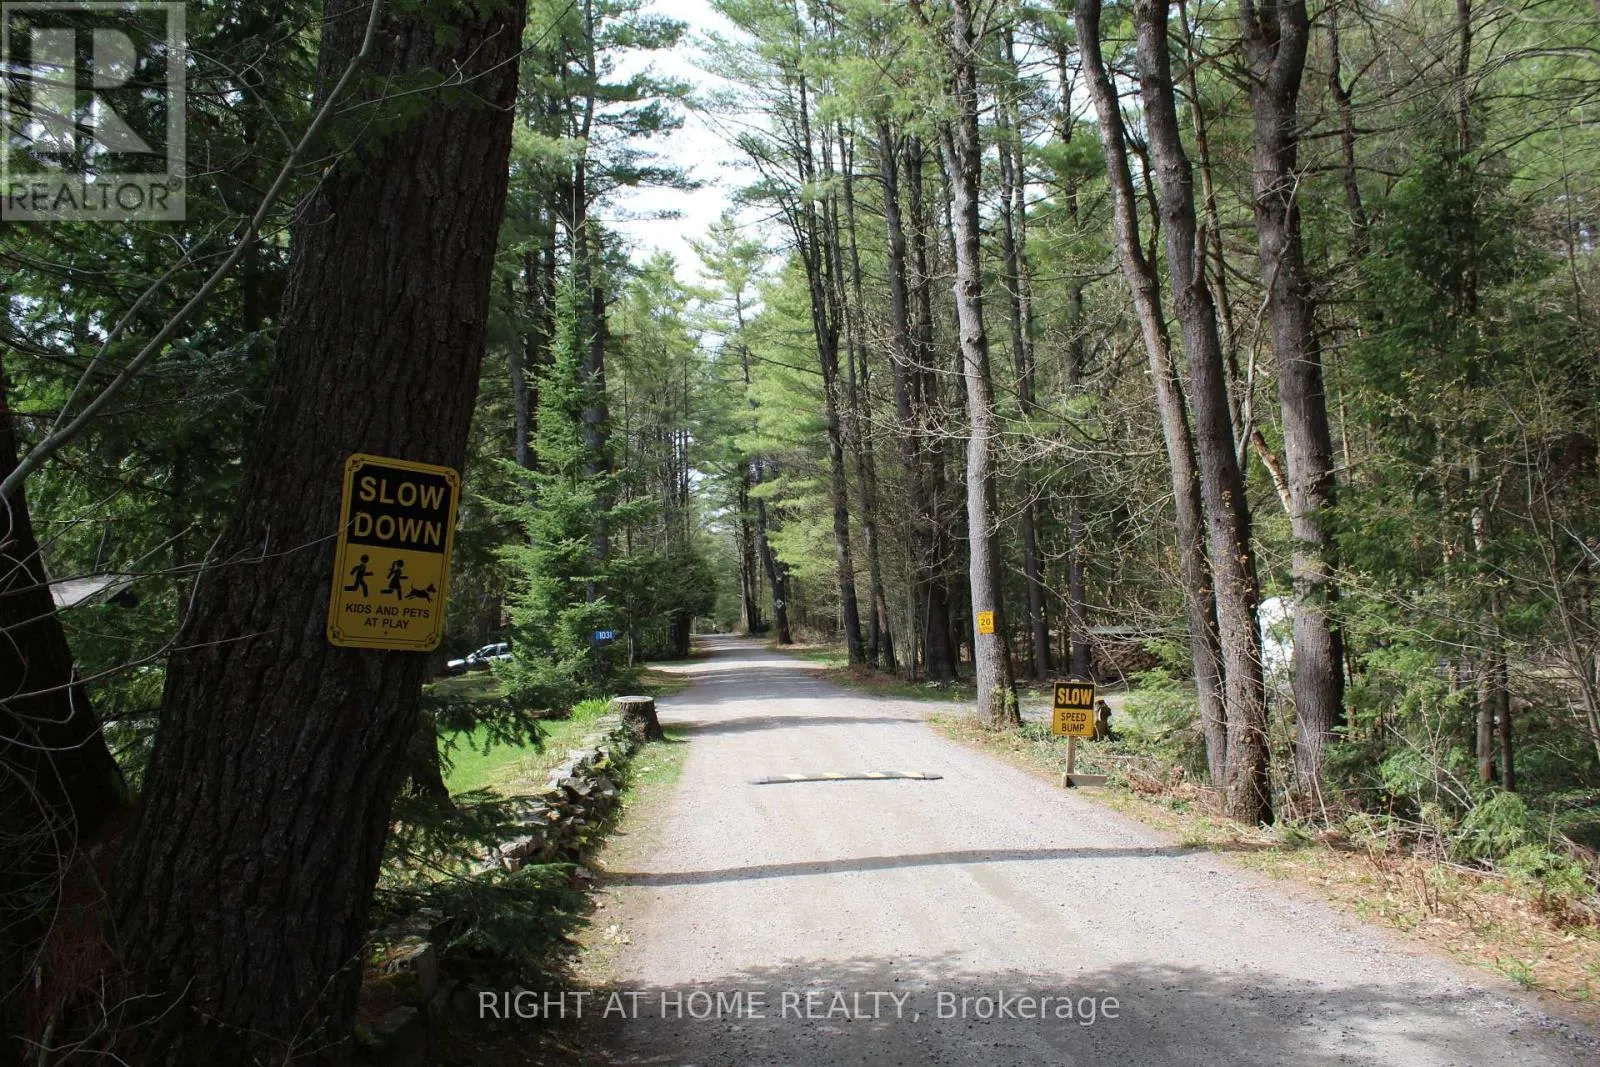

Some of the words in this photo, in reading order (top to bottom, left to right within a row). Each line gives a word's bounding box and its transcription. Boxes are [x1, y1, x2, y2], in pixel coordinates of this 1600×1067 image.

[359, 475, 445, 511] SLOW
[354, 511, 442, 546] DOWN
[345, 602, 372, 614] KIDS
[375, 605, 399, 616] AND
[402, 607, 430, 619] PETS
[364, 617, 379, 627] AT
[382, 618, 410, 629] PLAY
[980, 618, 991, 626] 20
[1057, 687, 1093, 705] SLOW
[1060, 712, 1087, 722] SPEED
[1061, 723, 1086, 732] BUMP
